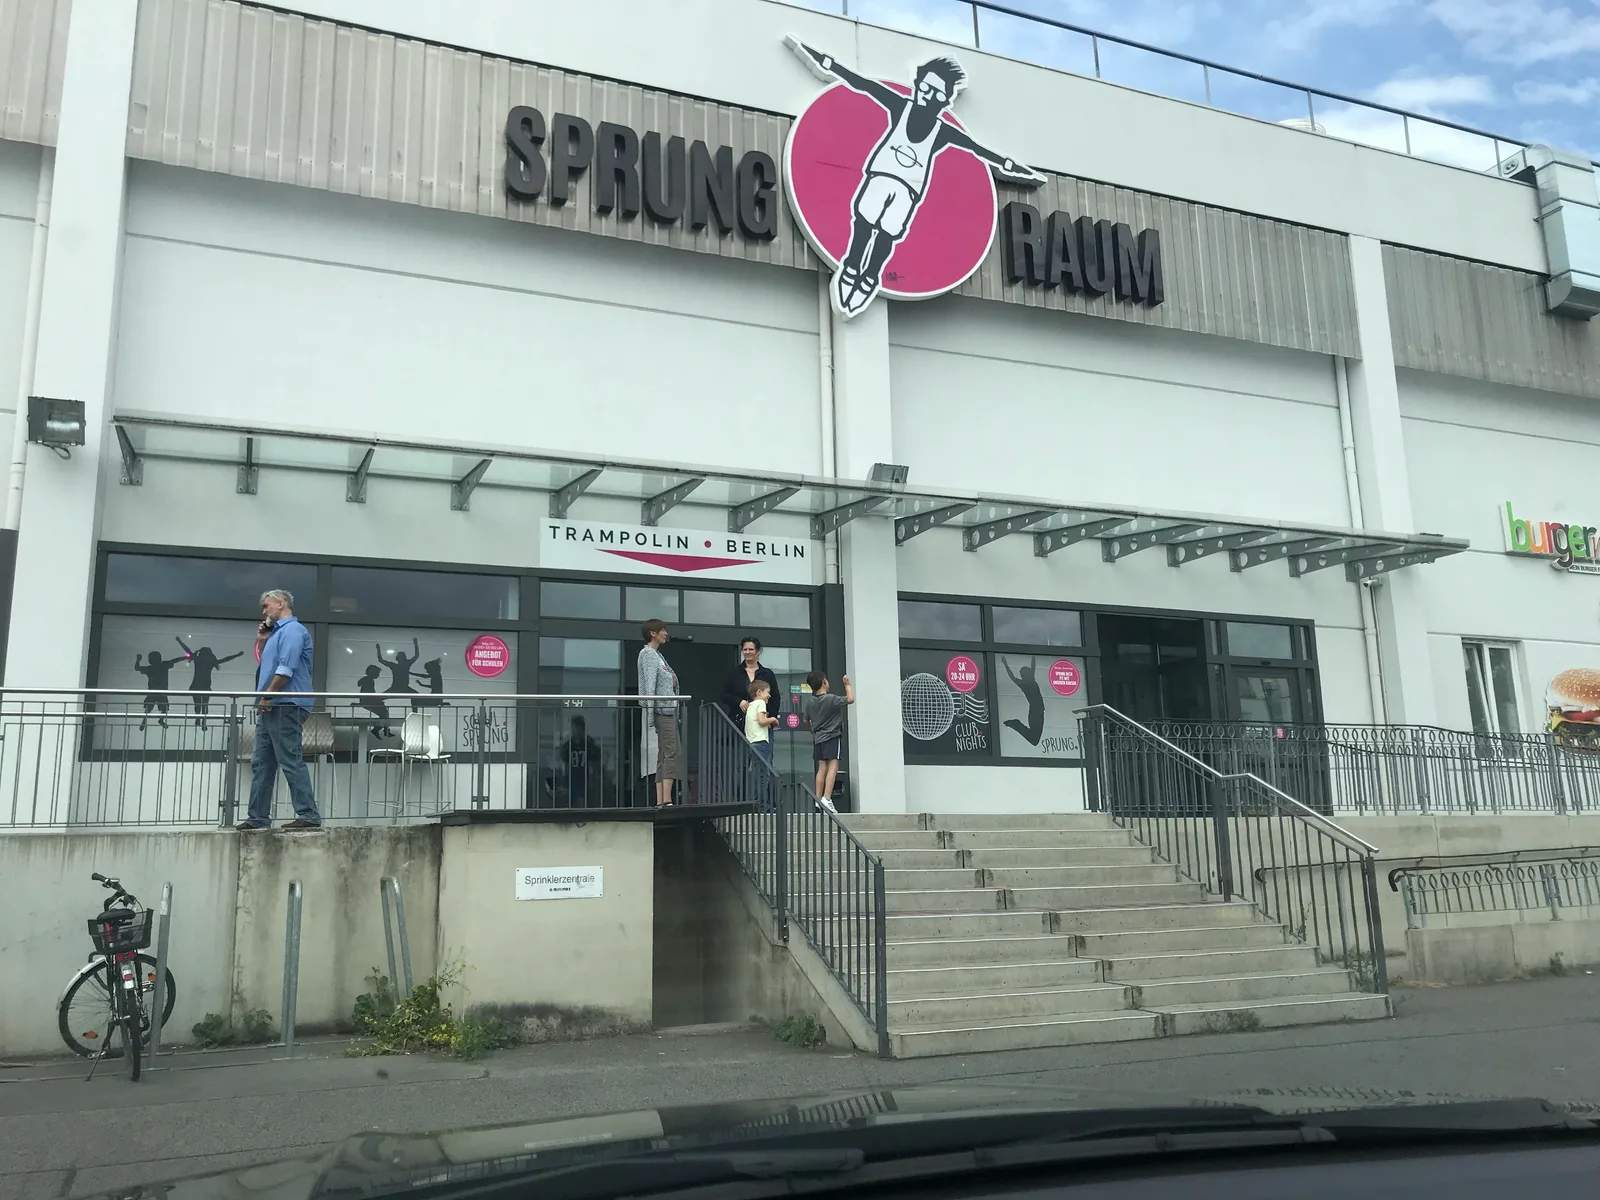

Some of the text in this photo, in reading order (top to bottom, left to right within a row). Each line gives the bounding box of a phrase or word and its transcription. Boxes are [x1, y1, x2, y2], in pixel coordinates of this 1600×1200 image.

[506, 106, 1165, 307] SPRUNG RAUM
[549, 525, 805, 558] TRAMPOLIN BERLIN
[1501, 501, 1600, 568] burger
[475, 650, 501, 659] ANGEBOT
[965, 673, 975, 681] UHR
[956, 735, 987, 752] NIGHTS
[524, 874, 595, 886] Sprinklerzentrale
